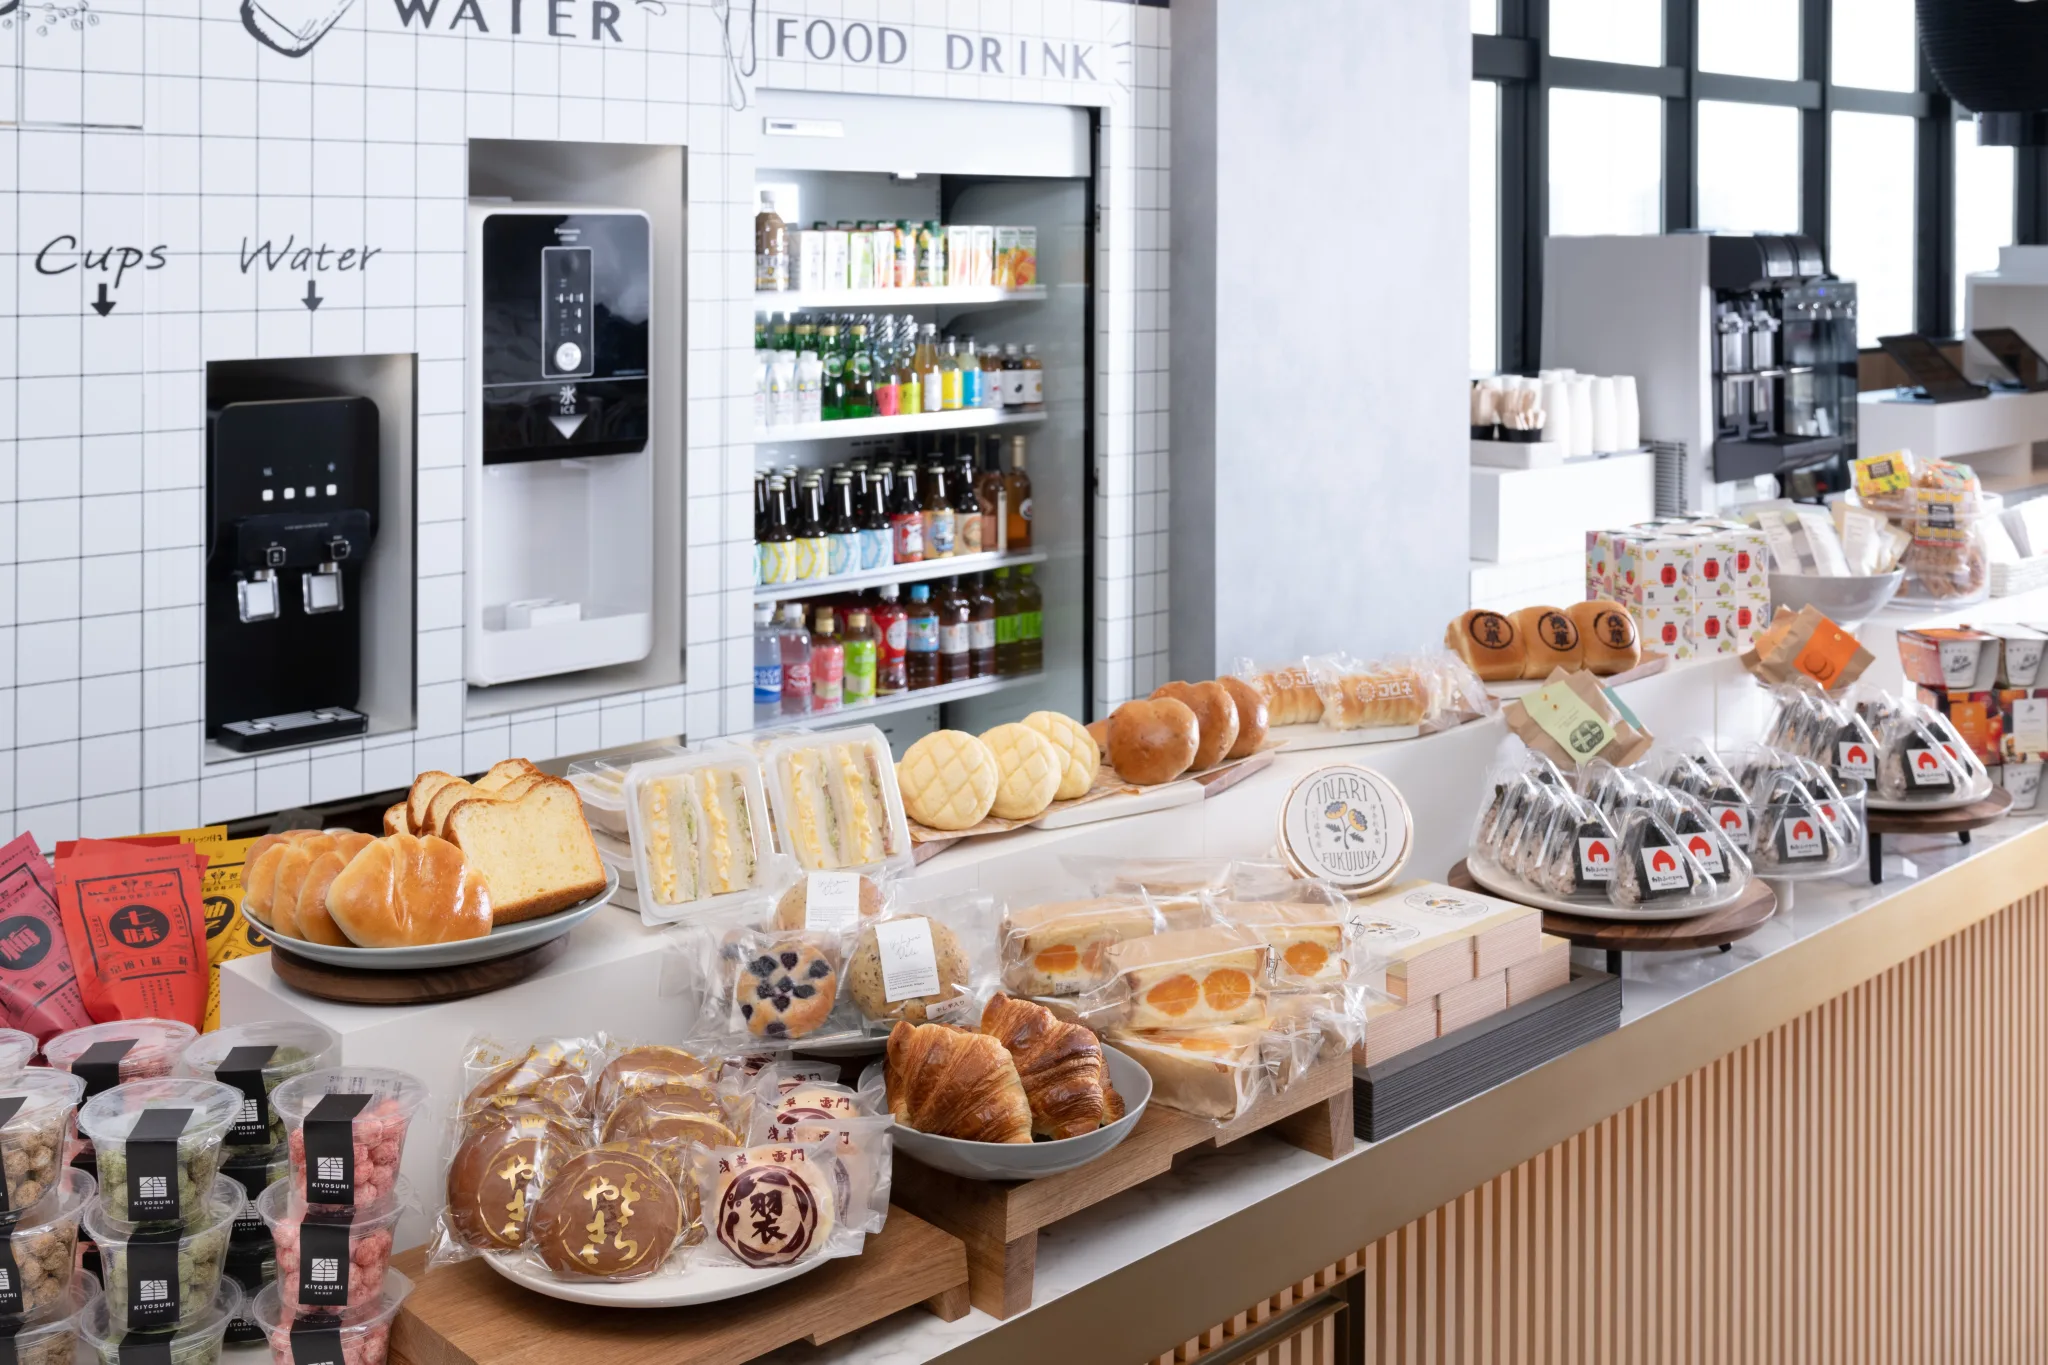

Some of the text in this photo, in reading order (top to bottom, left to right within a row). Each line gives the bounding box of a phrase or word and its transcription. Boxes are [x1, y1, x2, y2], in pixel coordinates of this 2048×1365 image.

[776, 18, 1097, 81] FOOD DRINK
[35, 235, 167, 289] Cups
[239, 234, 382, 275] Water
[559, 385, 576, 405] 氷
[560, 405, 575, 415] ICE
[1316, 777, 1368, 805] INARI
[1322, 850, 1378, 872] FUKUJUYA
[119, 910, 161, 944] 七味
[311, 1182, 350, 1190] KIYOSUMI
[133, 1199, 175, 1207] KIYOSUMI
[304, 1283, 344, 1291] KIYOSUMI
[133, 1301, 175, 1311] KIYOSUMI
